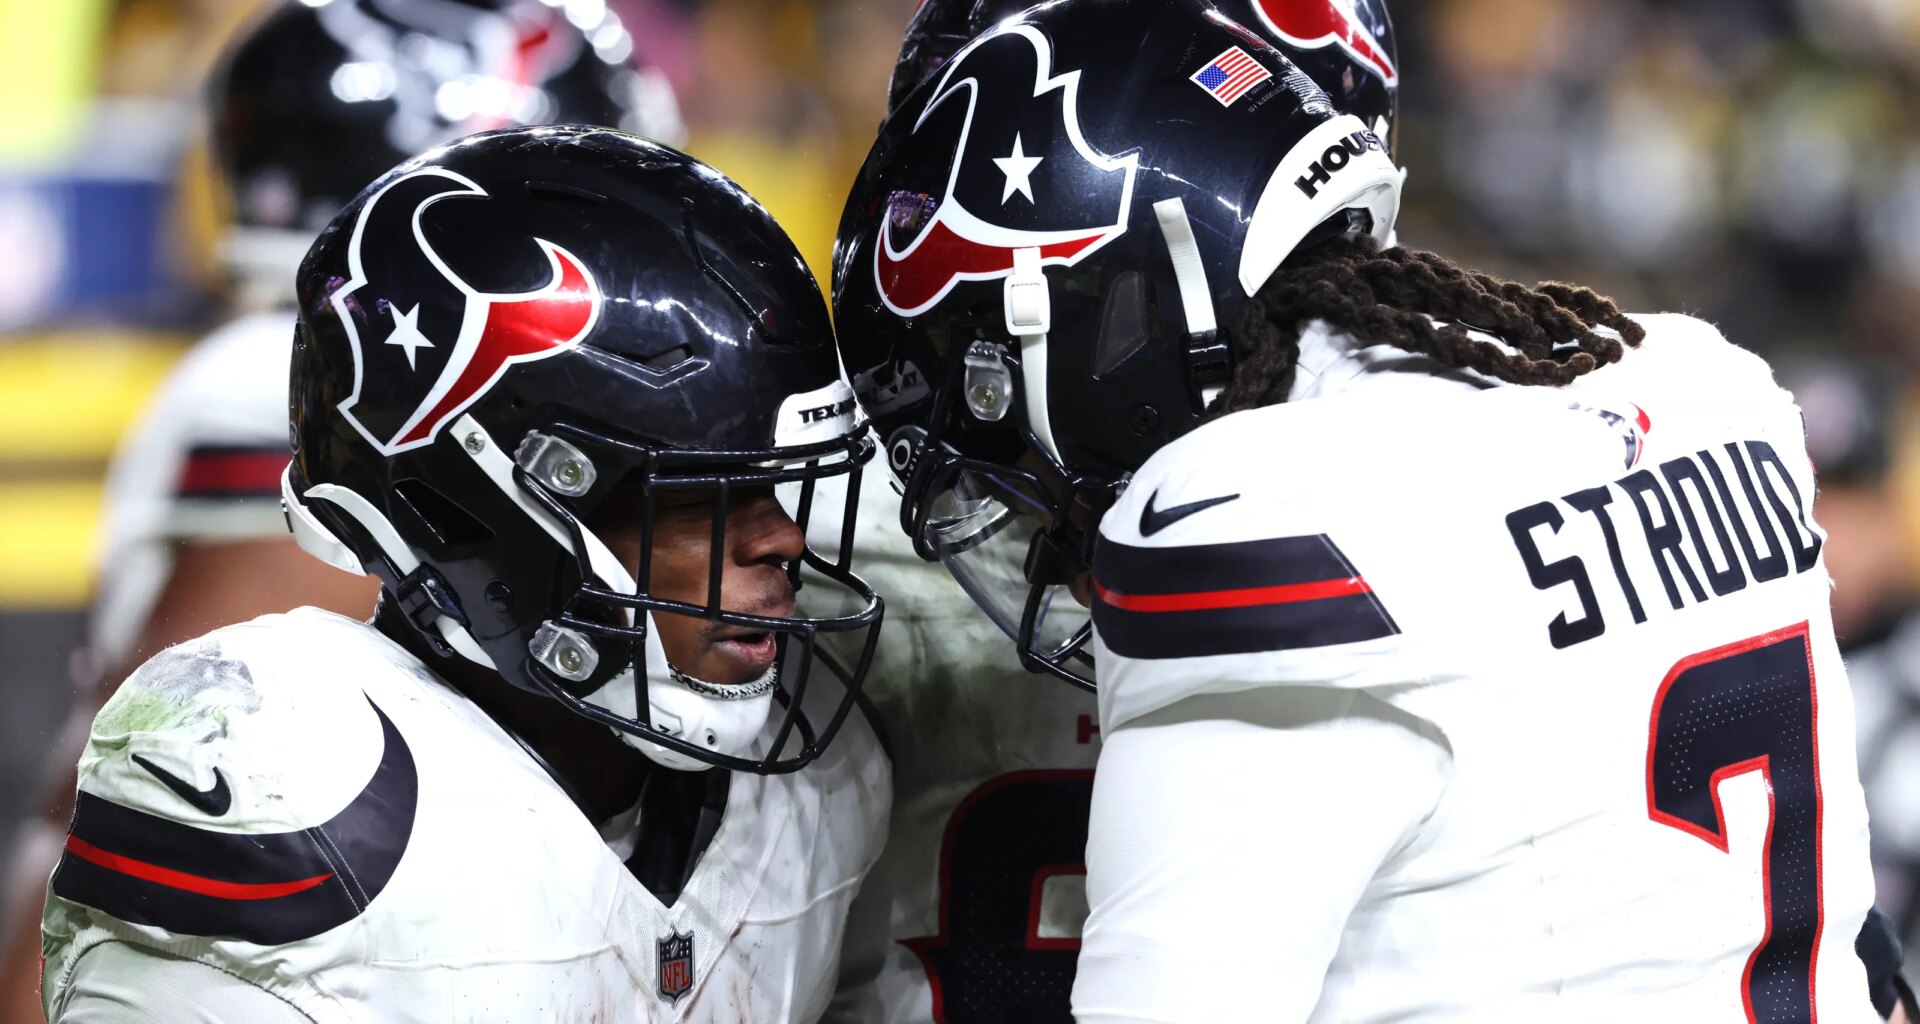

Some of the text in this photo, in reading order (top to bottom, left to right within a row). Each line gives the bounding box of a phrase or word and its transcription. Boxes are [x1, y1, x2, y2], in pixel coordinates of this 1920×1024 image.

[1505, 440, 1822, 650] STROUD
[1646, 619, 1824, 1024] 7
[661, 960, 690, 993] NFL
